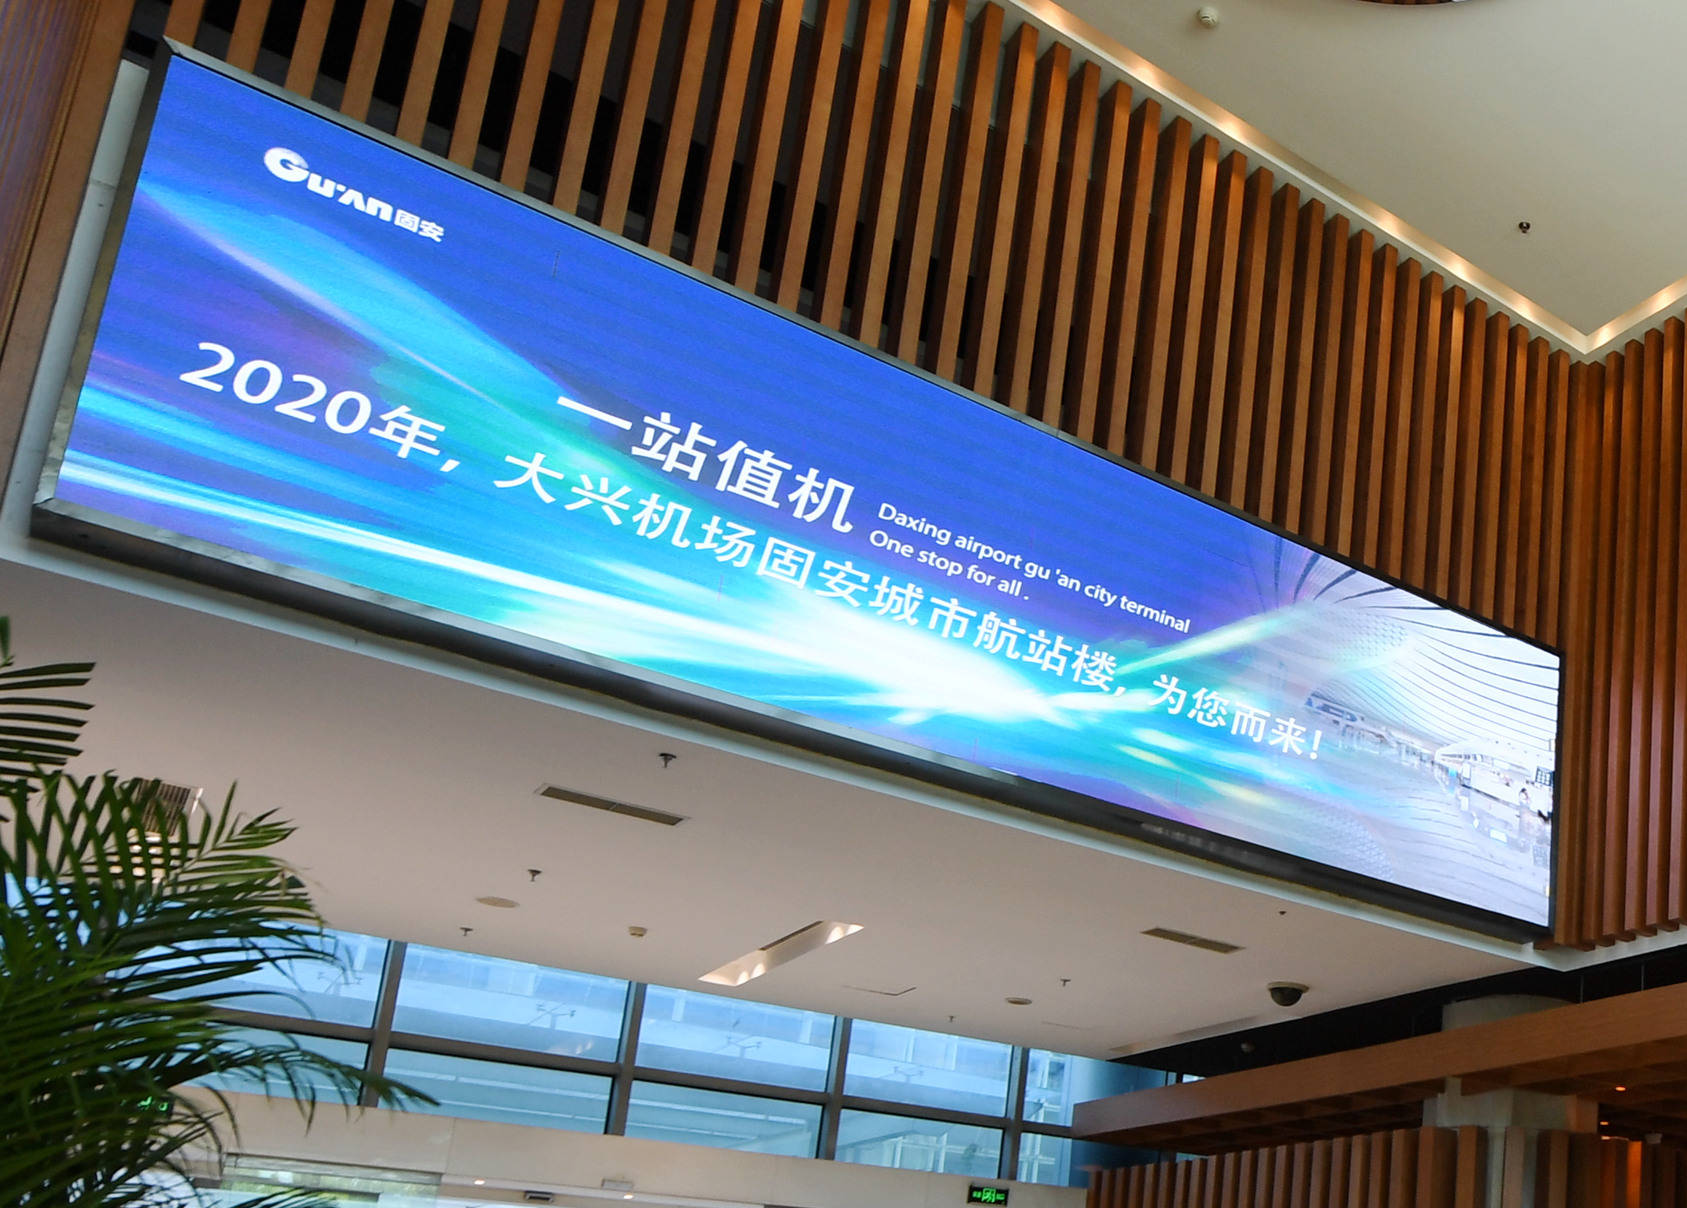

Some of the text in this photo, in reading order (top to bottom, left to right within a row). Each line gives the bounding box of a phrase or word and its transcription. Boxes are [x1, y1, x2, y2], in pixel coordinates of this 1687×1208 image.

[394, 209, 444, 242] 固安
[557, 396, 855, 533] 一站值机
[869, 529, 915, 558] One
[918, 548, 963, 577] stop
[966, 564, 996, 587] for
[878, 502, 951, 545] Daxing
[954, 534, 1023, 569] airport
[1024, 560, 1050, 580] gu
[1084, 583, 1118, 607] city
[1119, 595, 1191, 634] terminal
